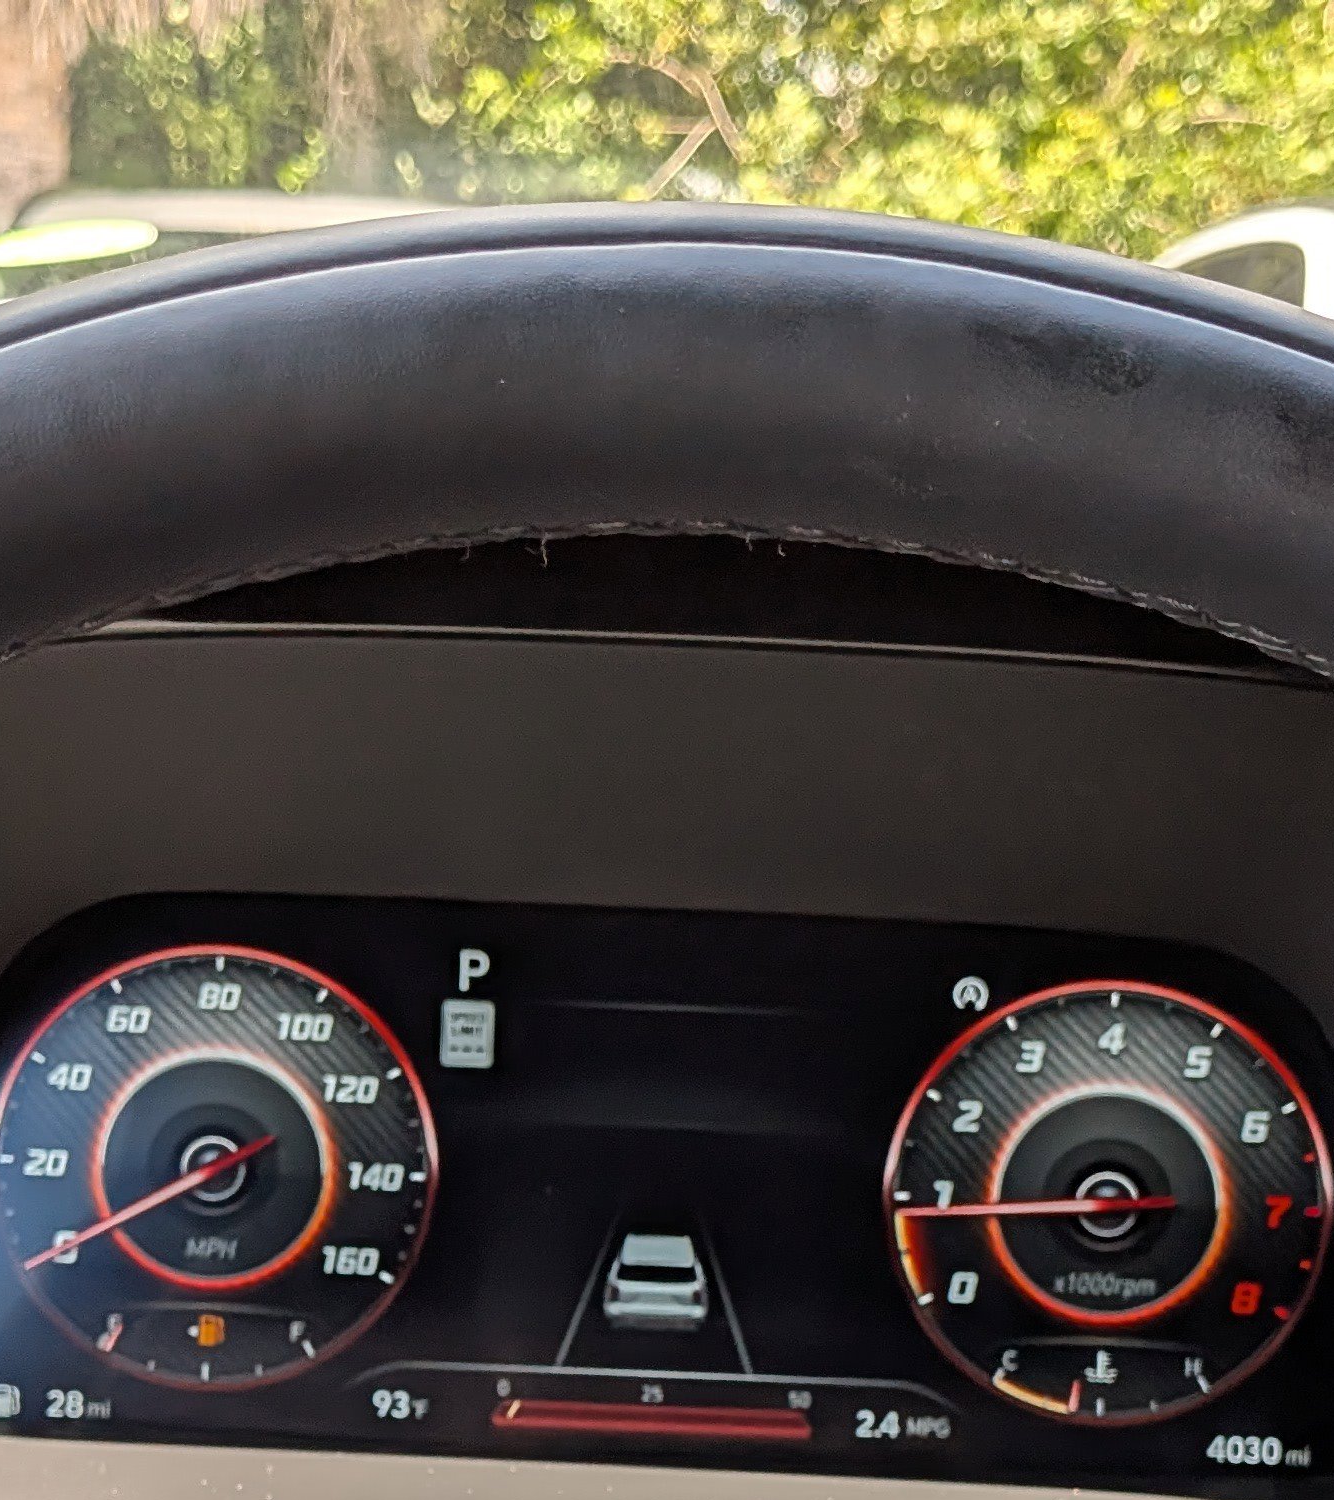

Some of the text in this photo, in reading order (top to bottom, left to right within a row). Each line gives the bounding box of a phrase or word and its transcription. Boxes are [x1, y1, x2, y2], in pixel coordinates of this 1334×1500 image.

[458, 948, 490, 992] P
[198, 982, 241, 1011] 80
[105, 1006, 150, 1033] 60
[276, 1014, 334, 1042] 100
[1098, 1022, 1127, 1055] 4
[1015, 1040, 1046, 1073] 3
[1184, 1046, 1213, 1079] 5
[47, 1064, 92, 1091] 40
[322, 1075, 380, 1104] 120
[953, 1100, 983, 1133] 2
[1241, 1111, 1271, 1143] 6
[22, 1149, 68, 1176] 20
[348, 1163, 405, 1192] 140
[933, 1180, 954, 1210] 1
[1266, 1196, 1292, 1229] 7
[185, 1235, 236, 1260] MPH
[322, 1246, 380, 1276] 160
[948, 1271, 978, 1304] 0
[1230, 1282, 1261, 1315] 8
[46, 1389, 84, 1418] 28
[372, 1389, 410, 1419] 93
[855, 1409, 900, 1438] 2.4
[1206, 1435, 1282, 1465] 4030
